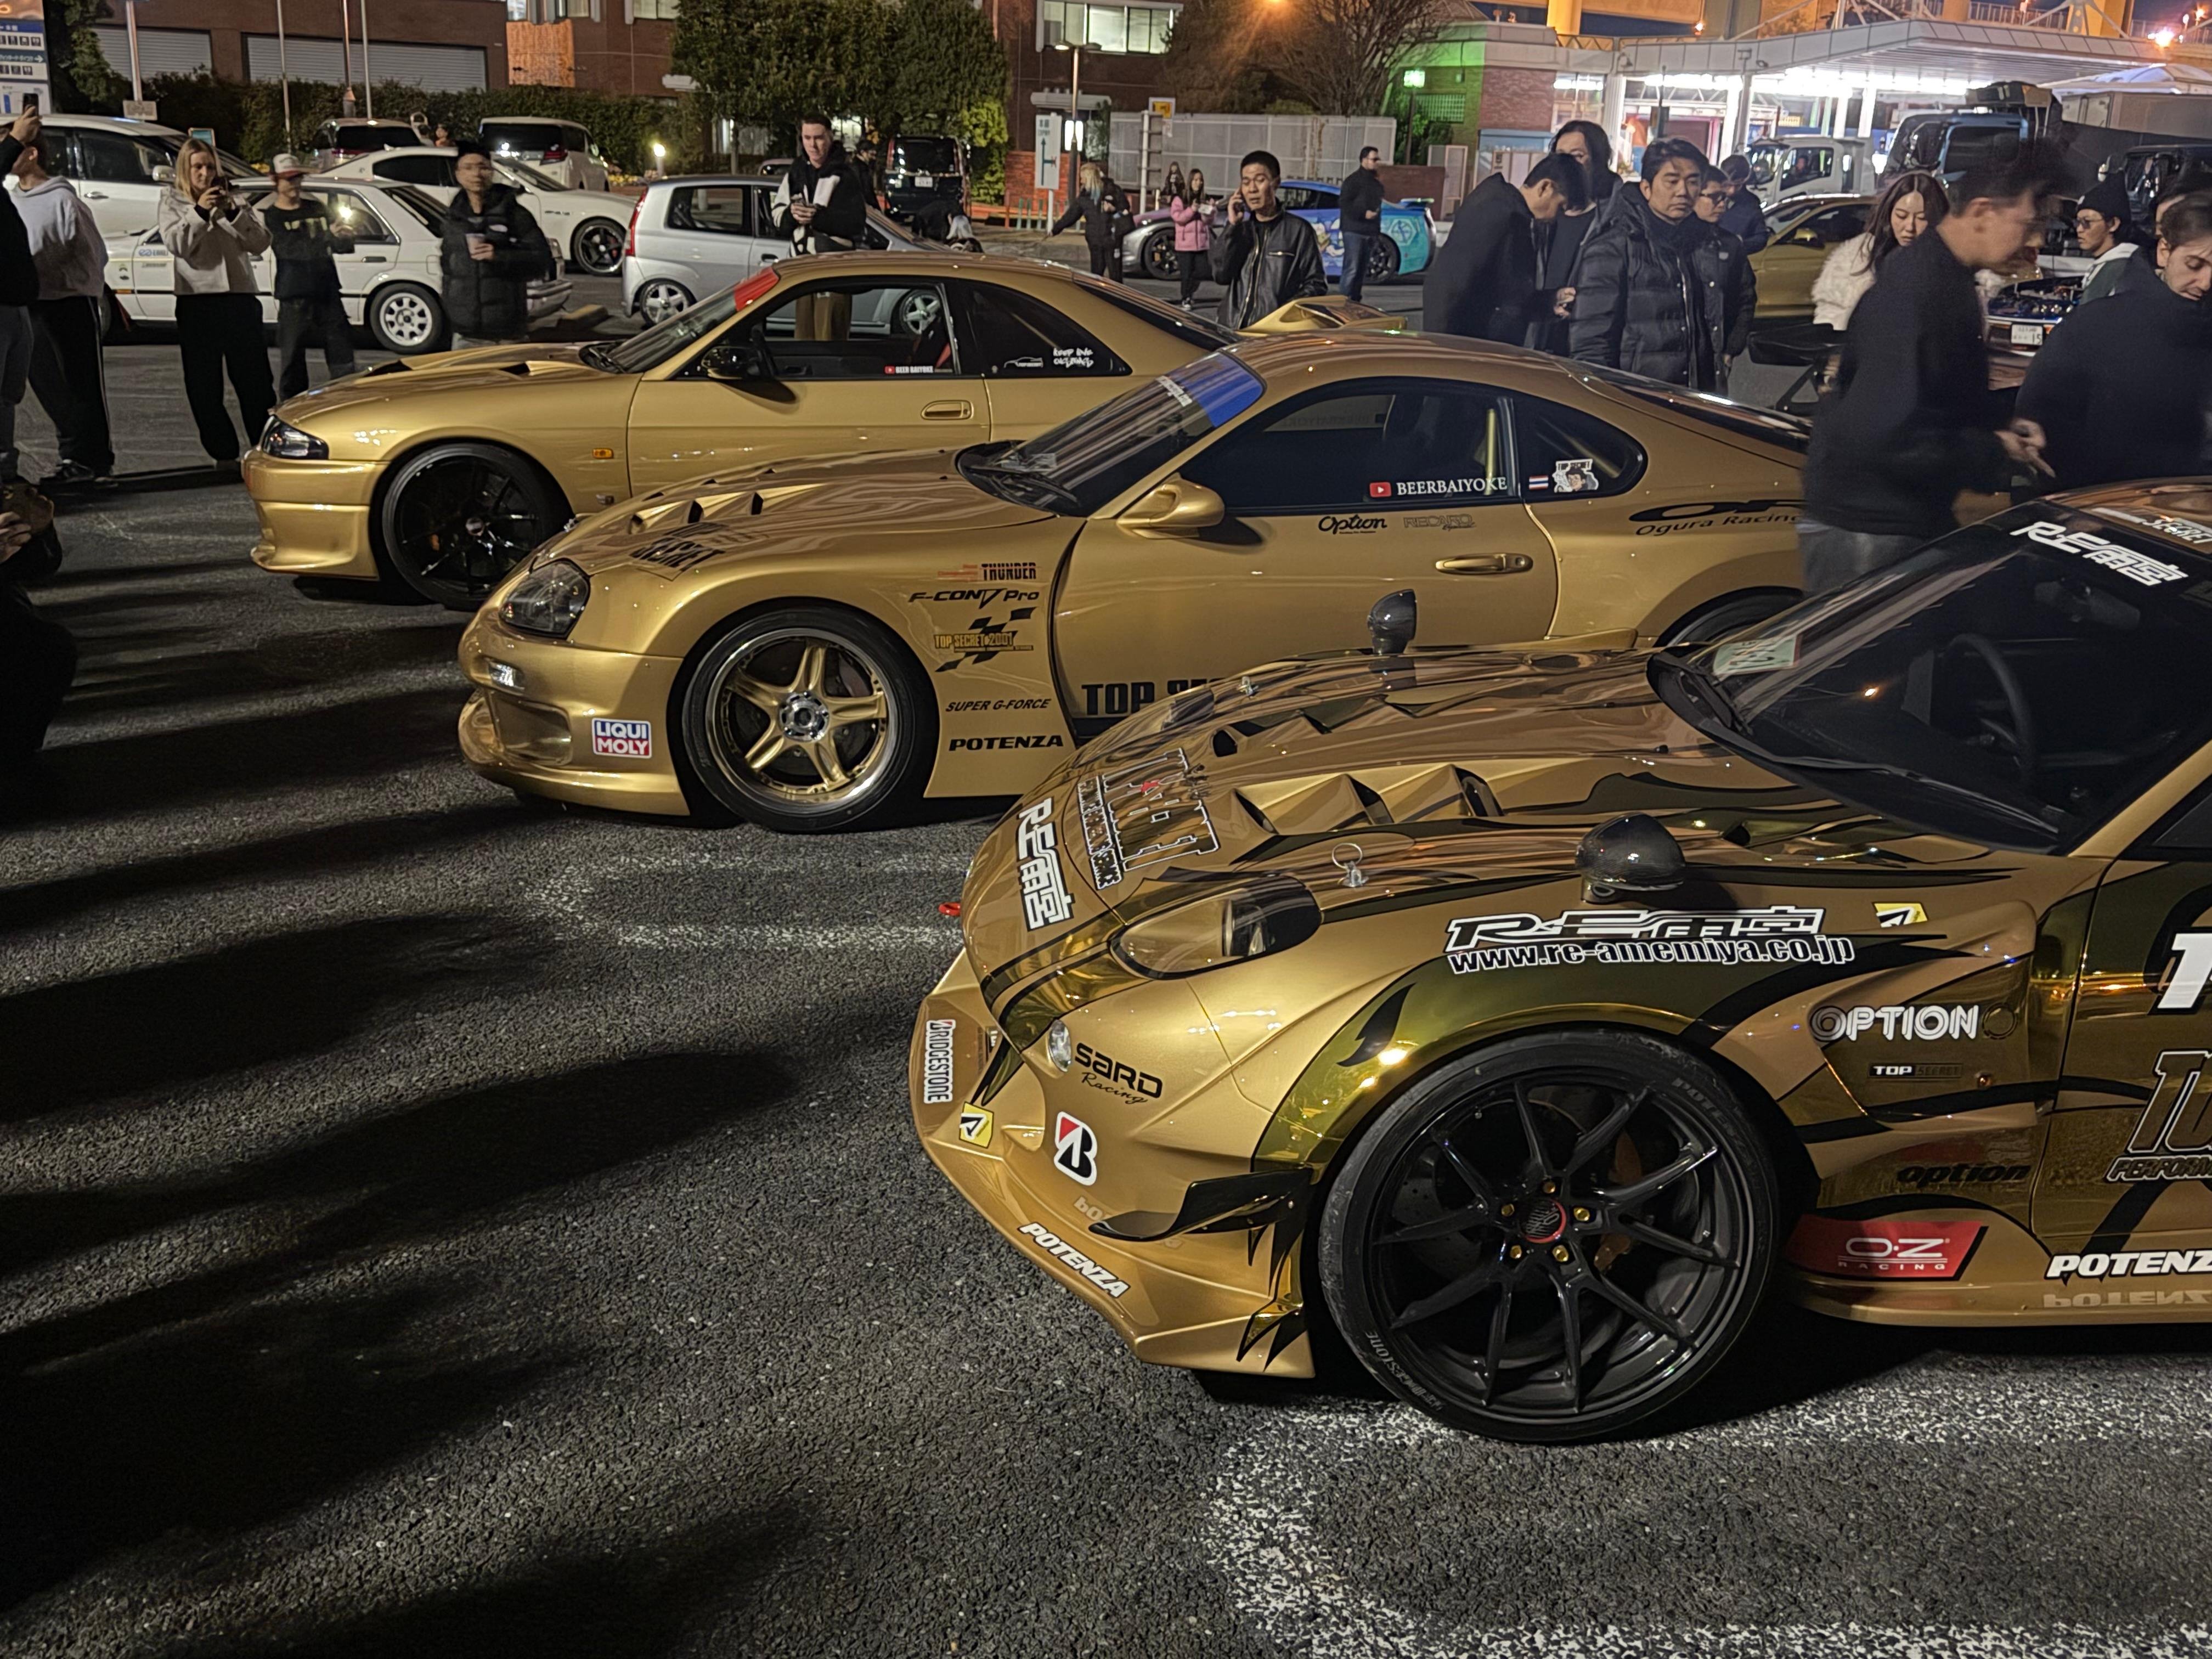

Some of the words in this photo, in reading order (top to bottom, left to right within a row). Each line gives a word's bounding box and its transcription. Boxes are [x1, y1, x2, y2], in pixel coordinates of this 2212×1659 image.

[1396, 477, 1508, 495] BEERBAIYOKE
[1318, 514, 1388, 534] Option
[1635, 521, 1713, 537] Ogura
[981, 562, 1036, 581] THUNDER
[1003, 590, 1040, 602] Pro
[934, 634, 952, 649] TOP
[953, 633, 985, 648] SECRET
[988, 632, 1014, 647] 2001
[945, 701, 991, 712] SUPER
[992, 698, 1052, 710] G-FORCE
[1081, 682, 1155, 715] TOP
[596, 721, 647, 739] LIQUI
[597, 737, 648, 755] MOLY
[949, 735, 1064, 751] POTENZA
[1448, 934, 1856, 975] www.re-amemiya.co.jp
[1809, 1005, 1979, 1042] OPTION
[924, 1019, 956, 1104] BRIDGESTONE
[1873, 1066, 1912, 1075] TOP
[1081, 1071, 1148, 1104] Racing
[1017, 1221, 1131, 1299] POTENZA
[1838, 1261, 1946, 1271] RACING
